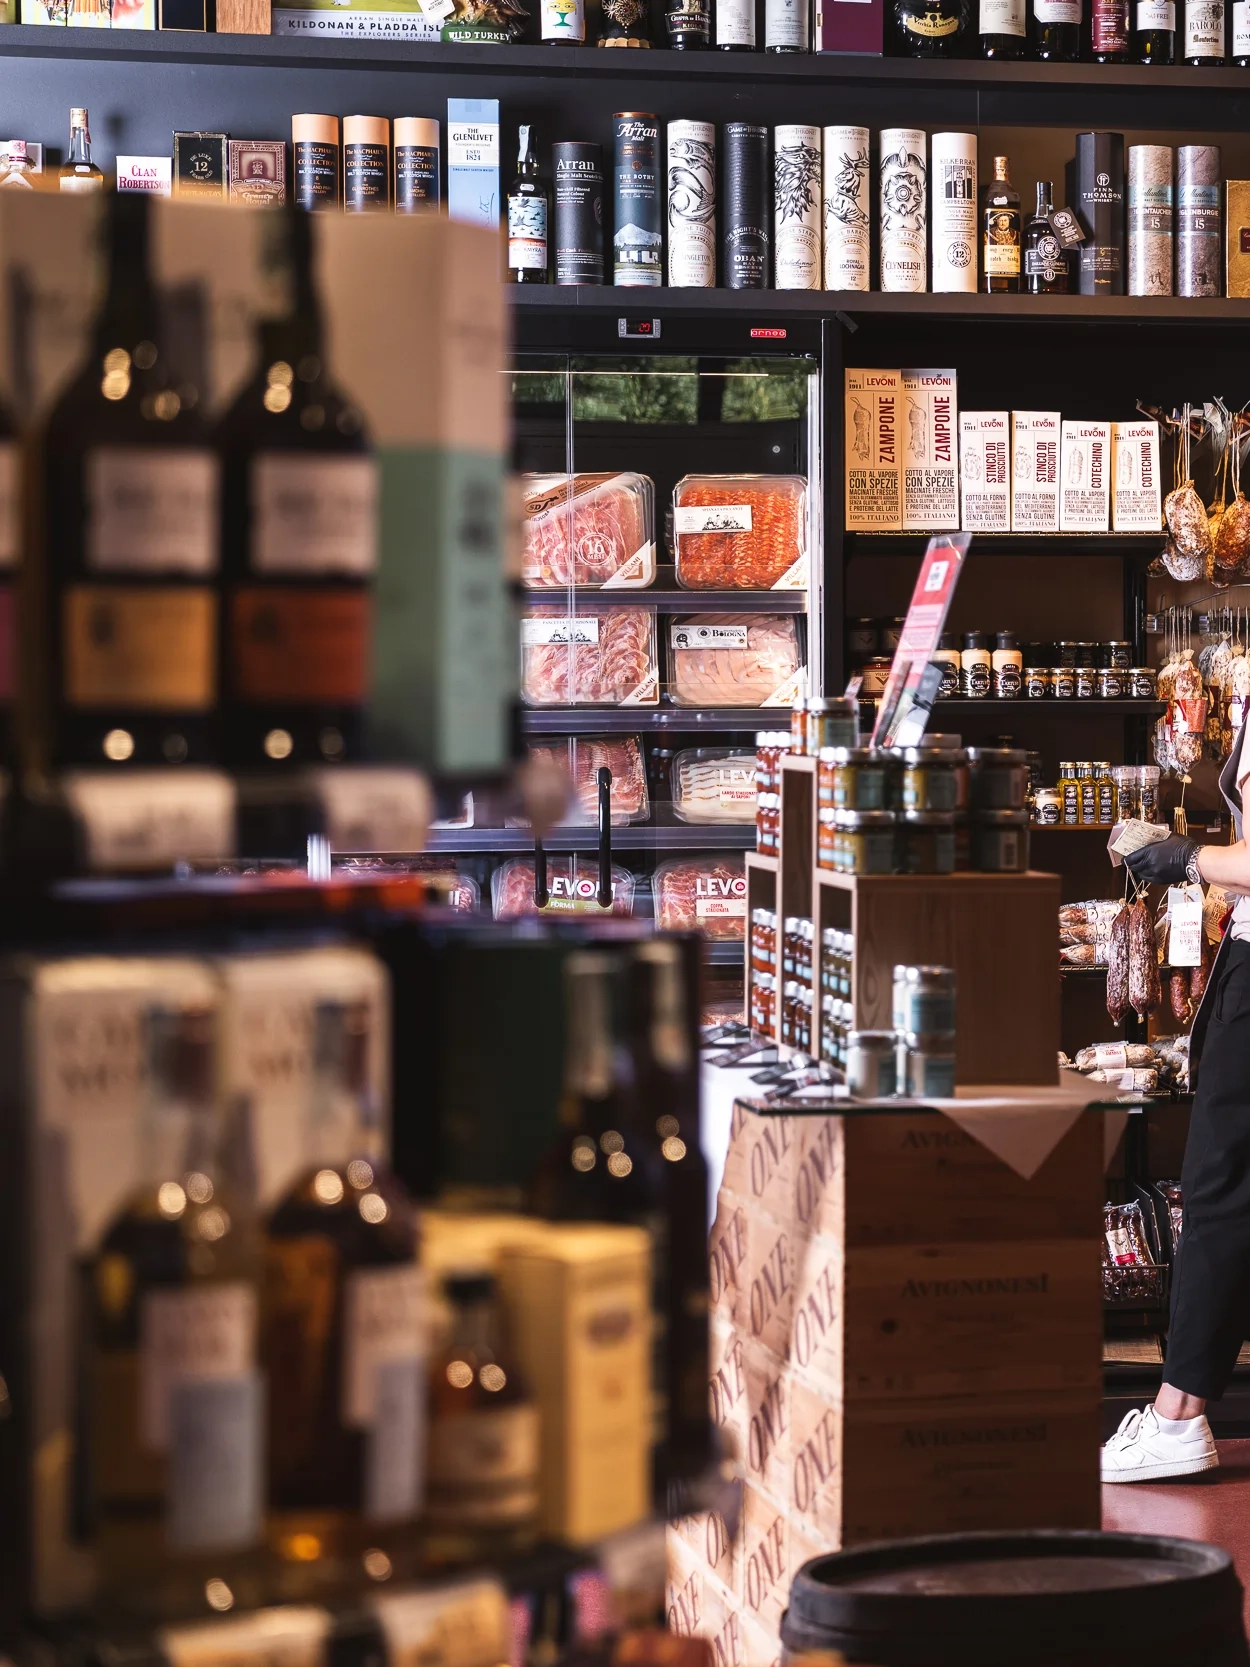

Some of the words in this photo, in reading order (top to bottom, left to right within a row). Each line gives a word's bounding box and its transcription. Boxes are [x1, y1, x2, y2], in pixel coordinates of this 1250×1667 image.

[288, 19, 355, 30] KILDONAN
[358, 22, 366, 30] &
[370, 22, 417, 32] PLADDA
[1189, 22, 1221, 31] BAROLO
[448, 31, 471, 40] WILD
[474, 31, 510, 42] TURKEY
[617, 123, 658, 138] Arran
[452, 133, 494, 142] GLENLIVET
[131, 164, 157, 177] CLAN
[194, 161, 208, 172] 12
[557, 159, 595, 170] Arran
[118, 175, 171, 190] ROBERTSON
[1151, 218, 1160, 229] 15
[1195, 219, 1205, 229] 15
[734, 255, 763, 263] OBAN
[885, 261, 921, 270] CLYNELISH
[867, 377, 896, 386] LEVONI
[921, 377, 951, 386] LEVONI
[879, 397, 895, 464] ZAMPONE
[934, 396, 951, 462] ZAMPONE
[1080, 429, 1106, 437] LEVONI
[986, 442, 997, 450] DI
[1036, 442, 1047, 450] DI
[986, 452, 997, 483] STINCO
[997, 442, 1006, 483] PROSCIUTTO
[1036, 452, 1047, 483] STINCO
[1047, 442, 1057, 483] PROSCIUTTO
[1091, 443, 1102, 488] COTECHINO
[1141, 442, 1152, 487] COTECHINO
[849, 478, 867, 488] CON
[869, 479, 899, 489] SPEZIE
[905, 477, 923, 487] CON
[926, 477, 955, 487] SPEZIE
[587, 540, 604, 553] 16
[620, 556, 640, 578] VILLANI
[634, 677, 655, 698] VILLANI
[696, 878, 747, 896] LEVO
[902, 1273, 1050, 1298] AVIGNONESI
